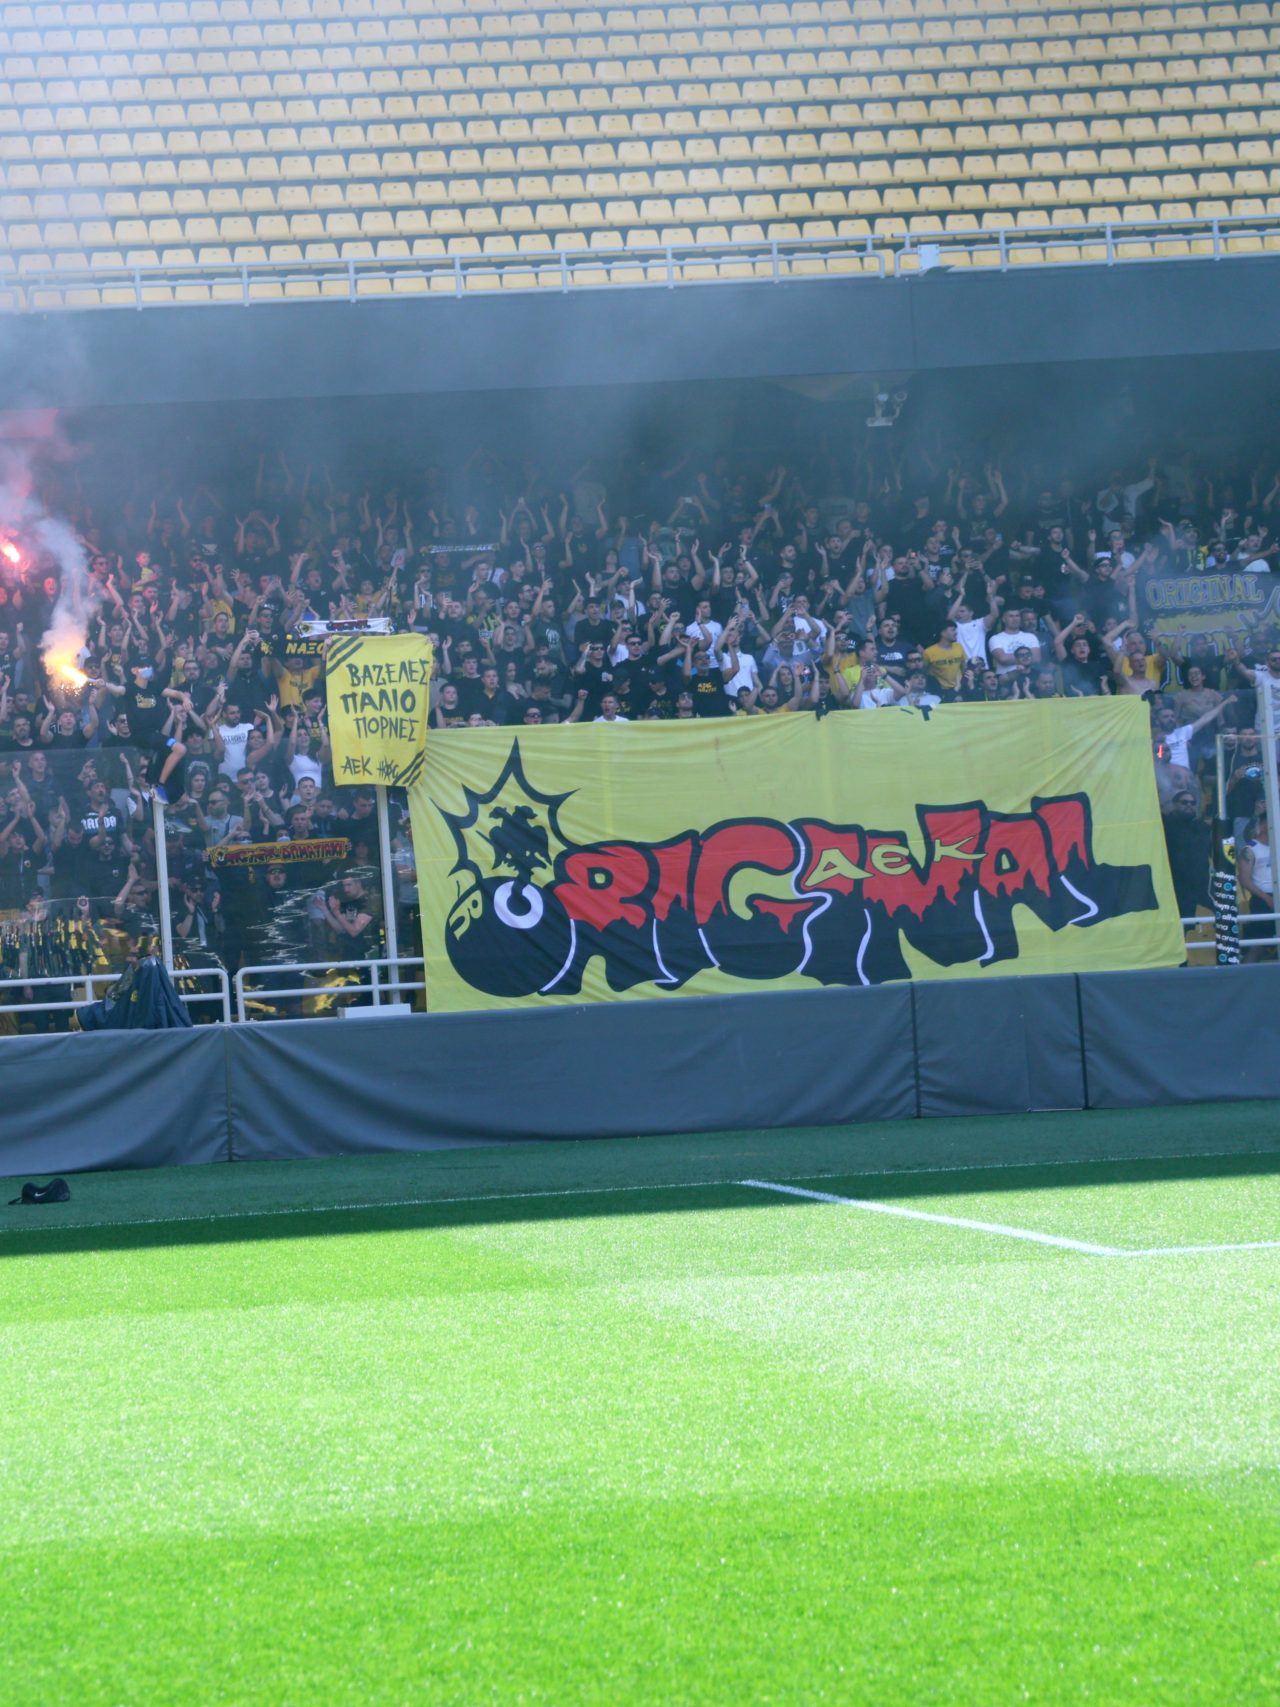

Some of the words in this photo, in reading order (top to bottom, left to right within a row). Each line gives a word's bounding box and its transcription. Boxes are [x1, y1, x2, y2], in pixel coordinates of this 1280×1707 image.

[1146, 574, 1265, 609] ORIGINAL
[285, 642, 325, 655] ΝΑΞΟ
[345, 659, 430, 687] ΒΑΖΕΛΕΣ
[340, 689, 417, 714] ΠΑΛΙΟ
[353, 715, 420, 742] ΠΟΡΝΕΣ
